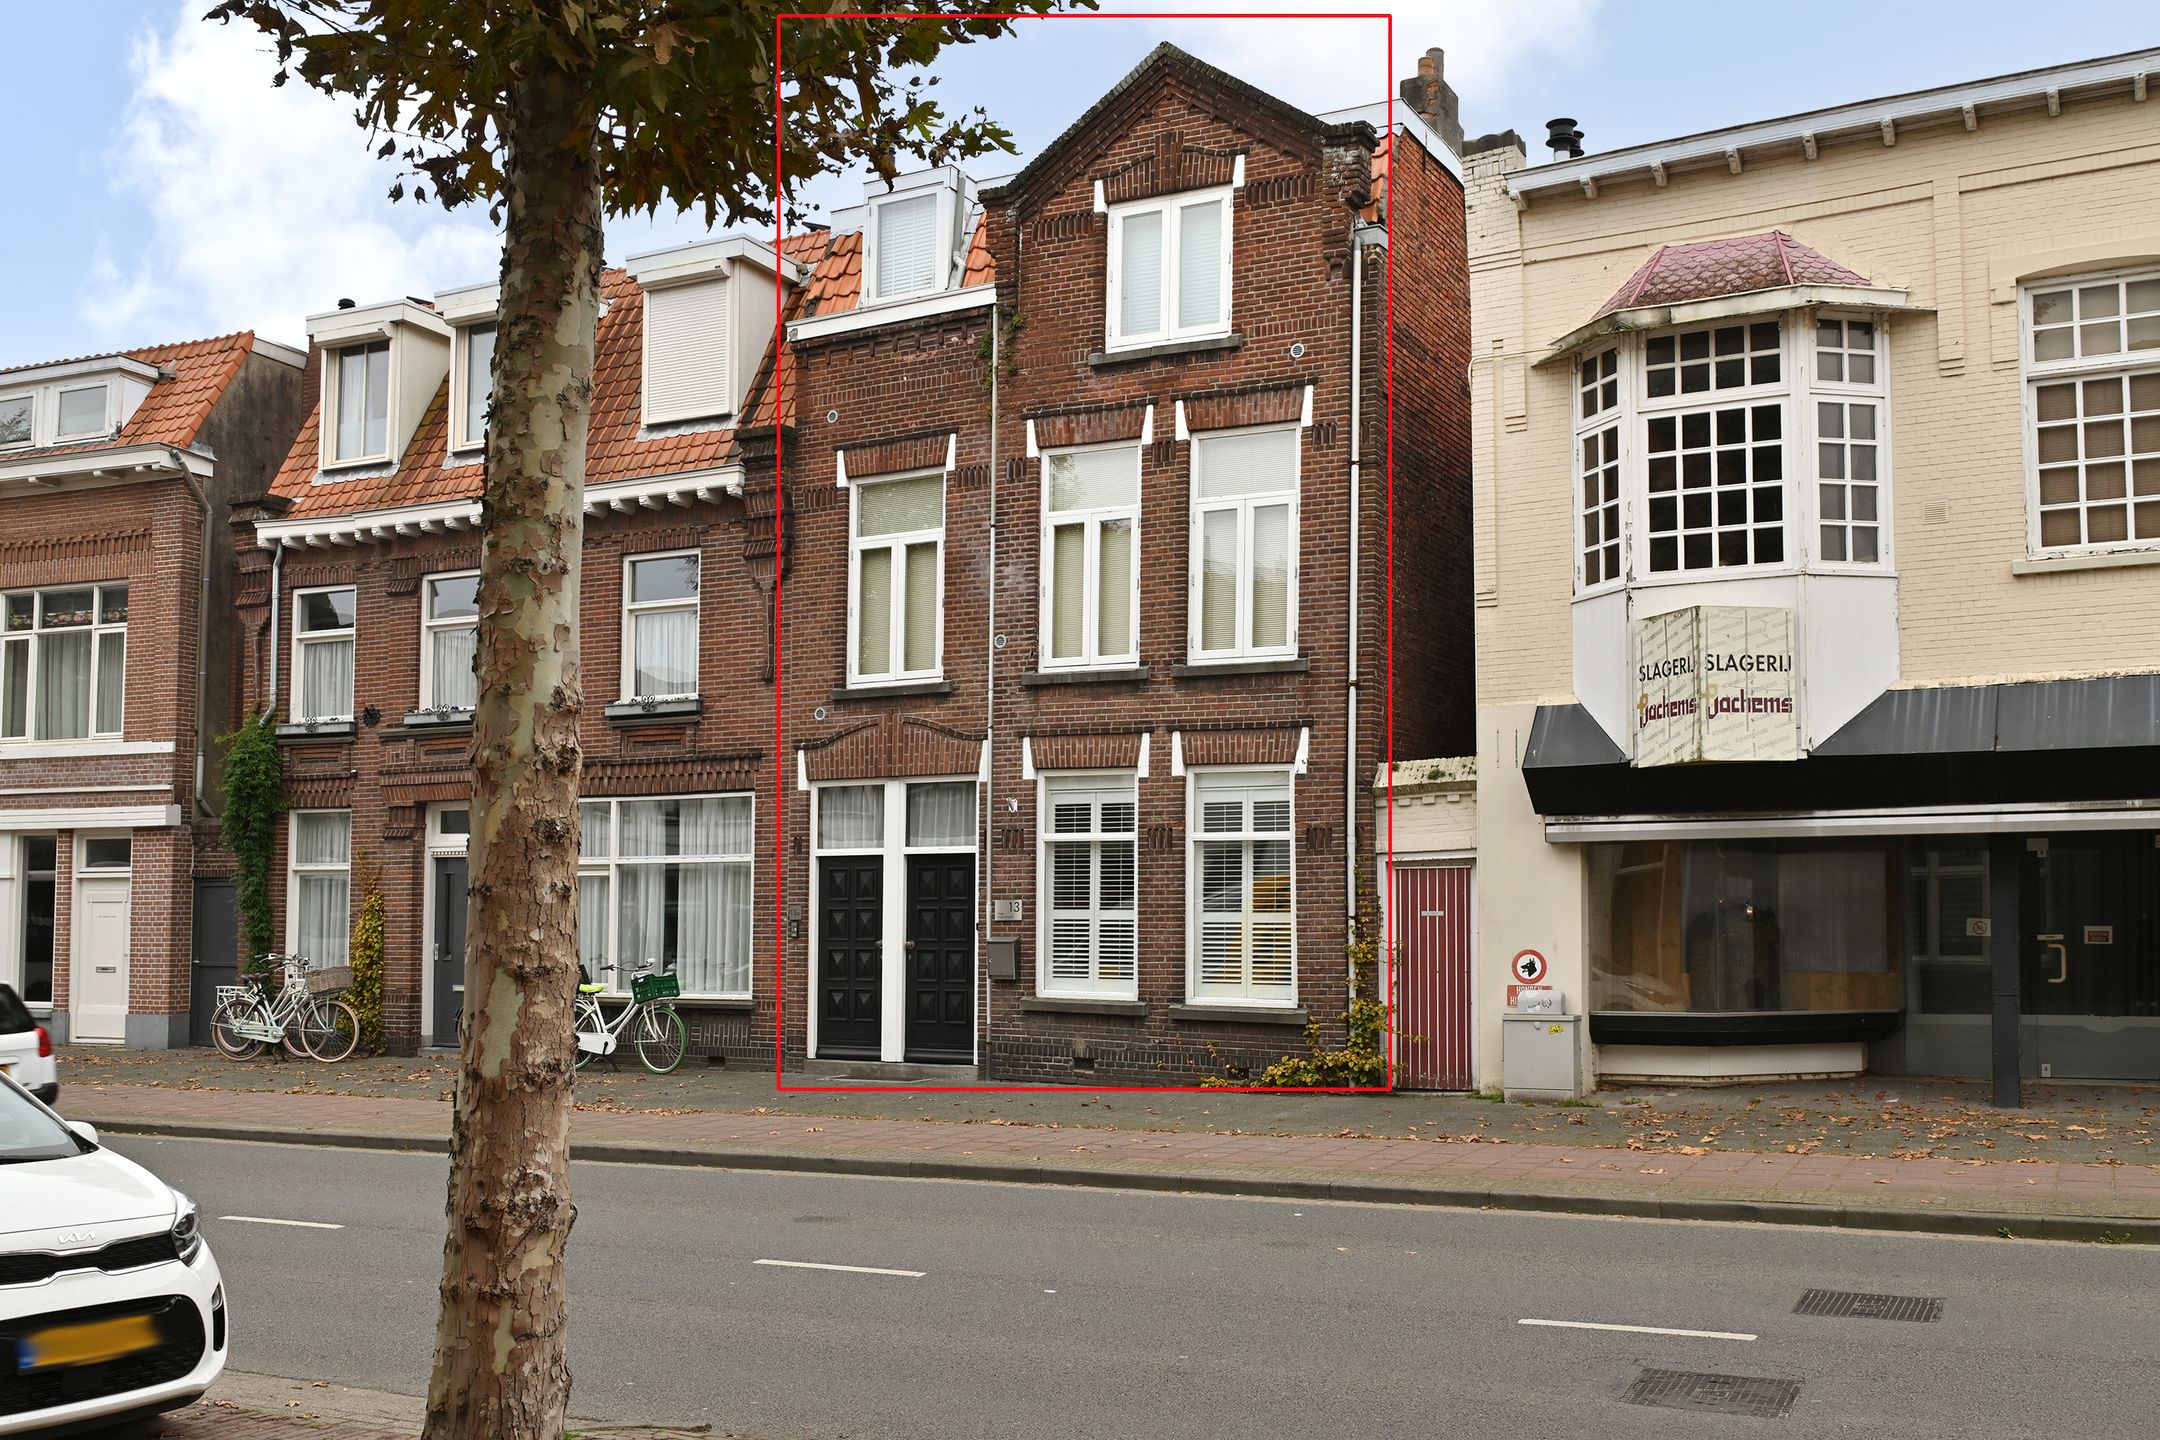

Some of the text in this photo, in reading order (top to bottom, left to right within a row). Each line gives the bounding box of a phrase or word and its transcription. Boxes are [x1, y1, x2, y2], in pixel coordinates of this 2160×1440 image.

[1638, 655, 1695, 683] SLAGERIJ
[1705, 653, 1792, 673] SLAGERIJ
[1009, 901, 1020, 912] 13
